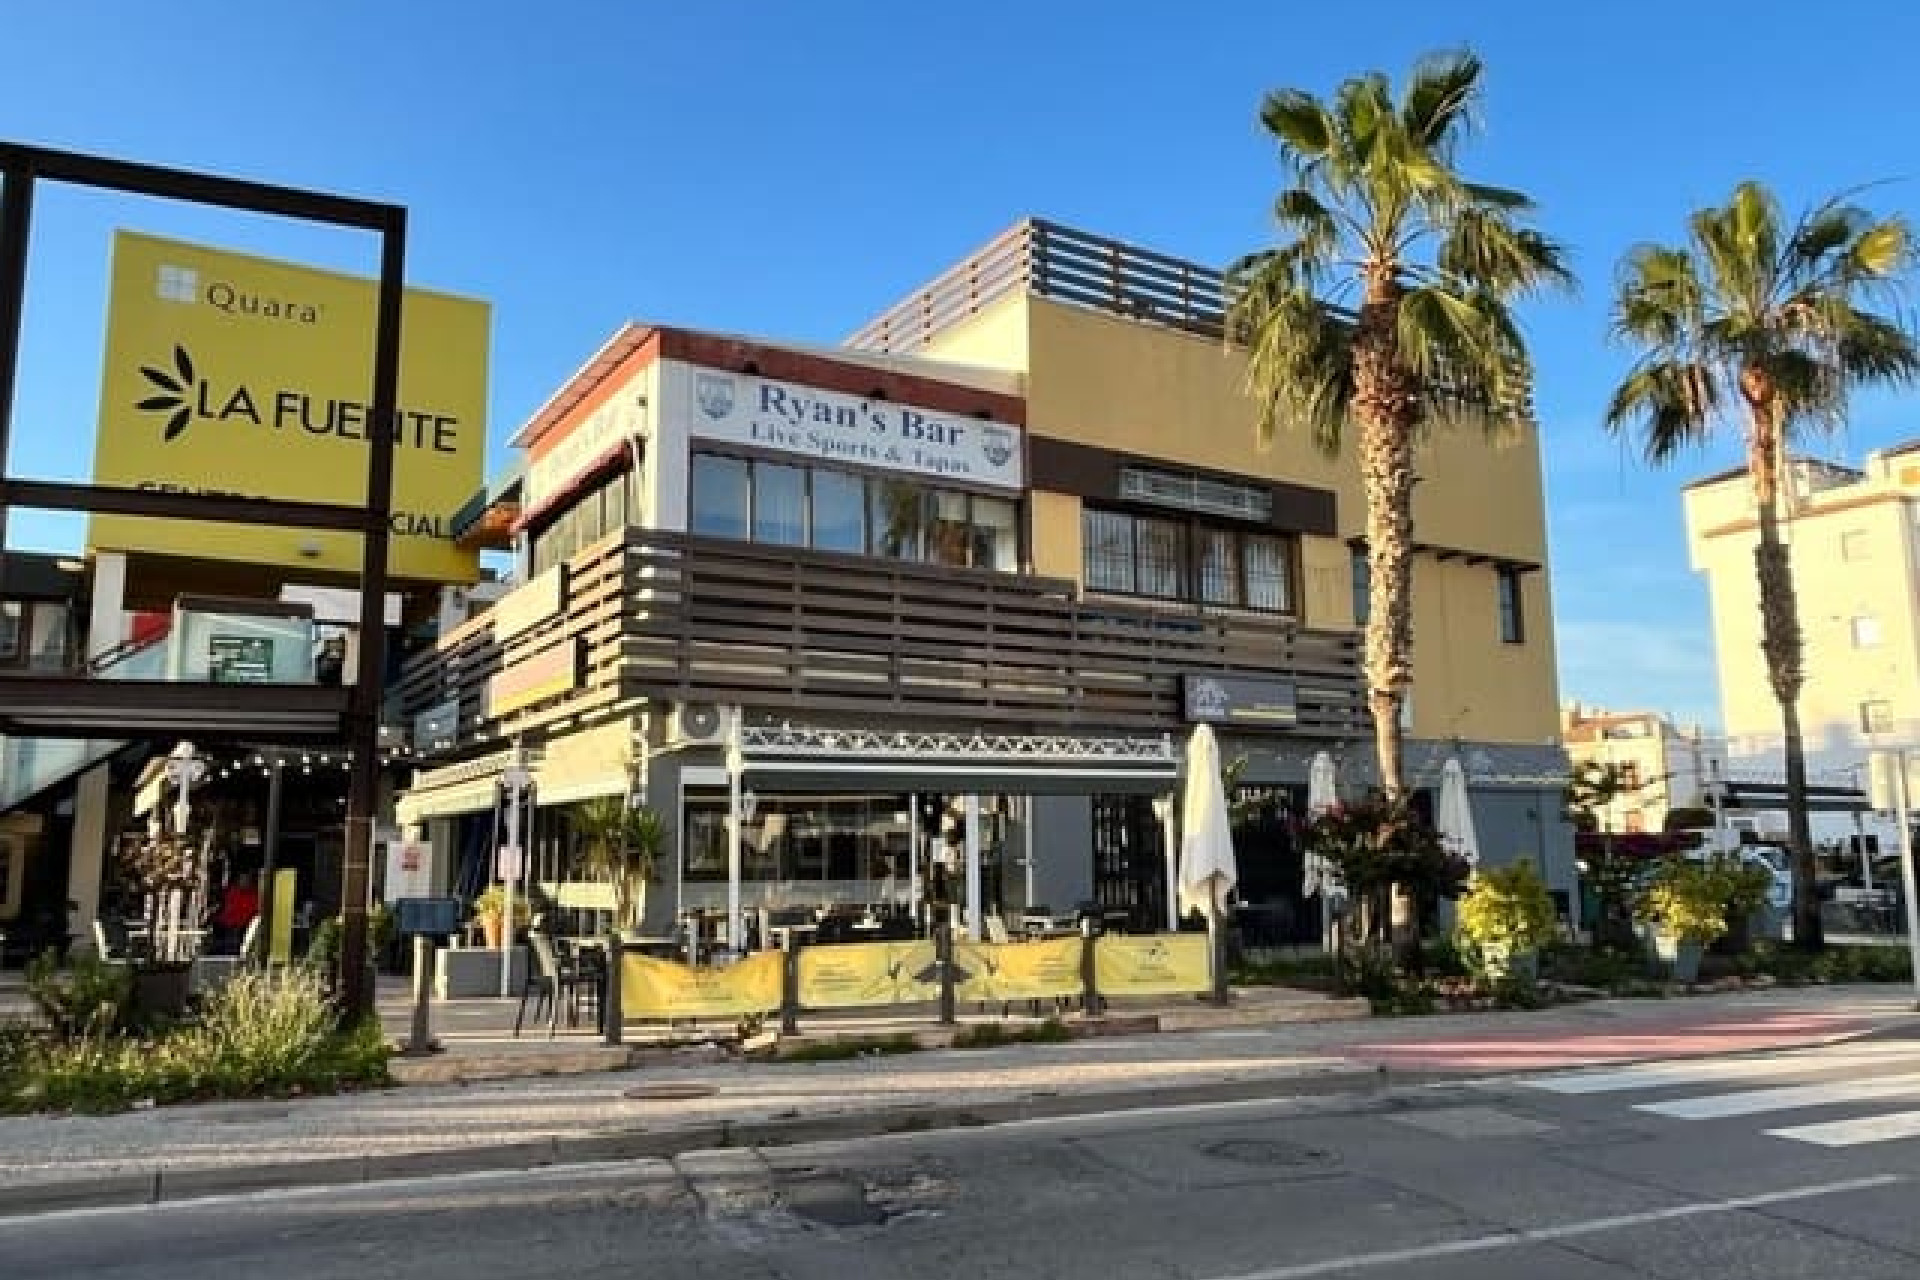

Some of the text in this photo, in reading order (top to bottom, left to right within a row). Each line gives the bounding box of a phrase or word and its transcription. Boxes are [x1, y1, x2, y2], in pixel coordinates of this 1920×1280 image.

[207, 282, 316, 323] Quara
[197, 378, 262, 425] LA
[761, 384, 966, 446] Ryan's Bar
[752, 422, 801, 446] Live
[807, 431, 877, 459] Sports
[884, 446, 902, 464] &
